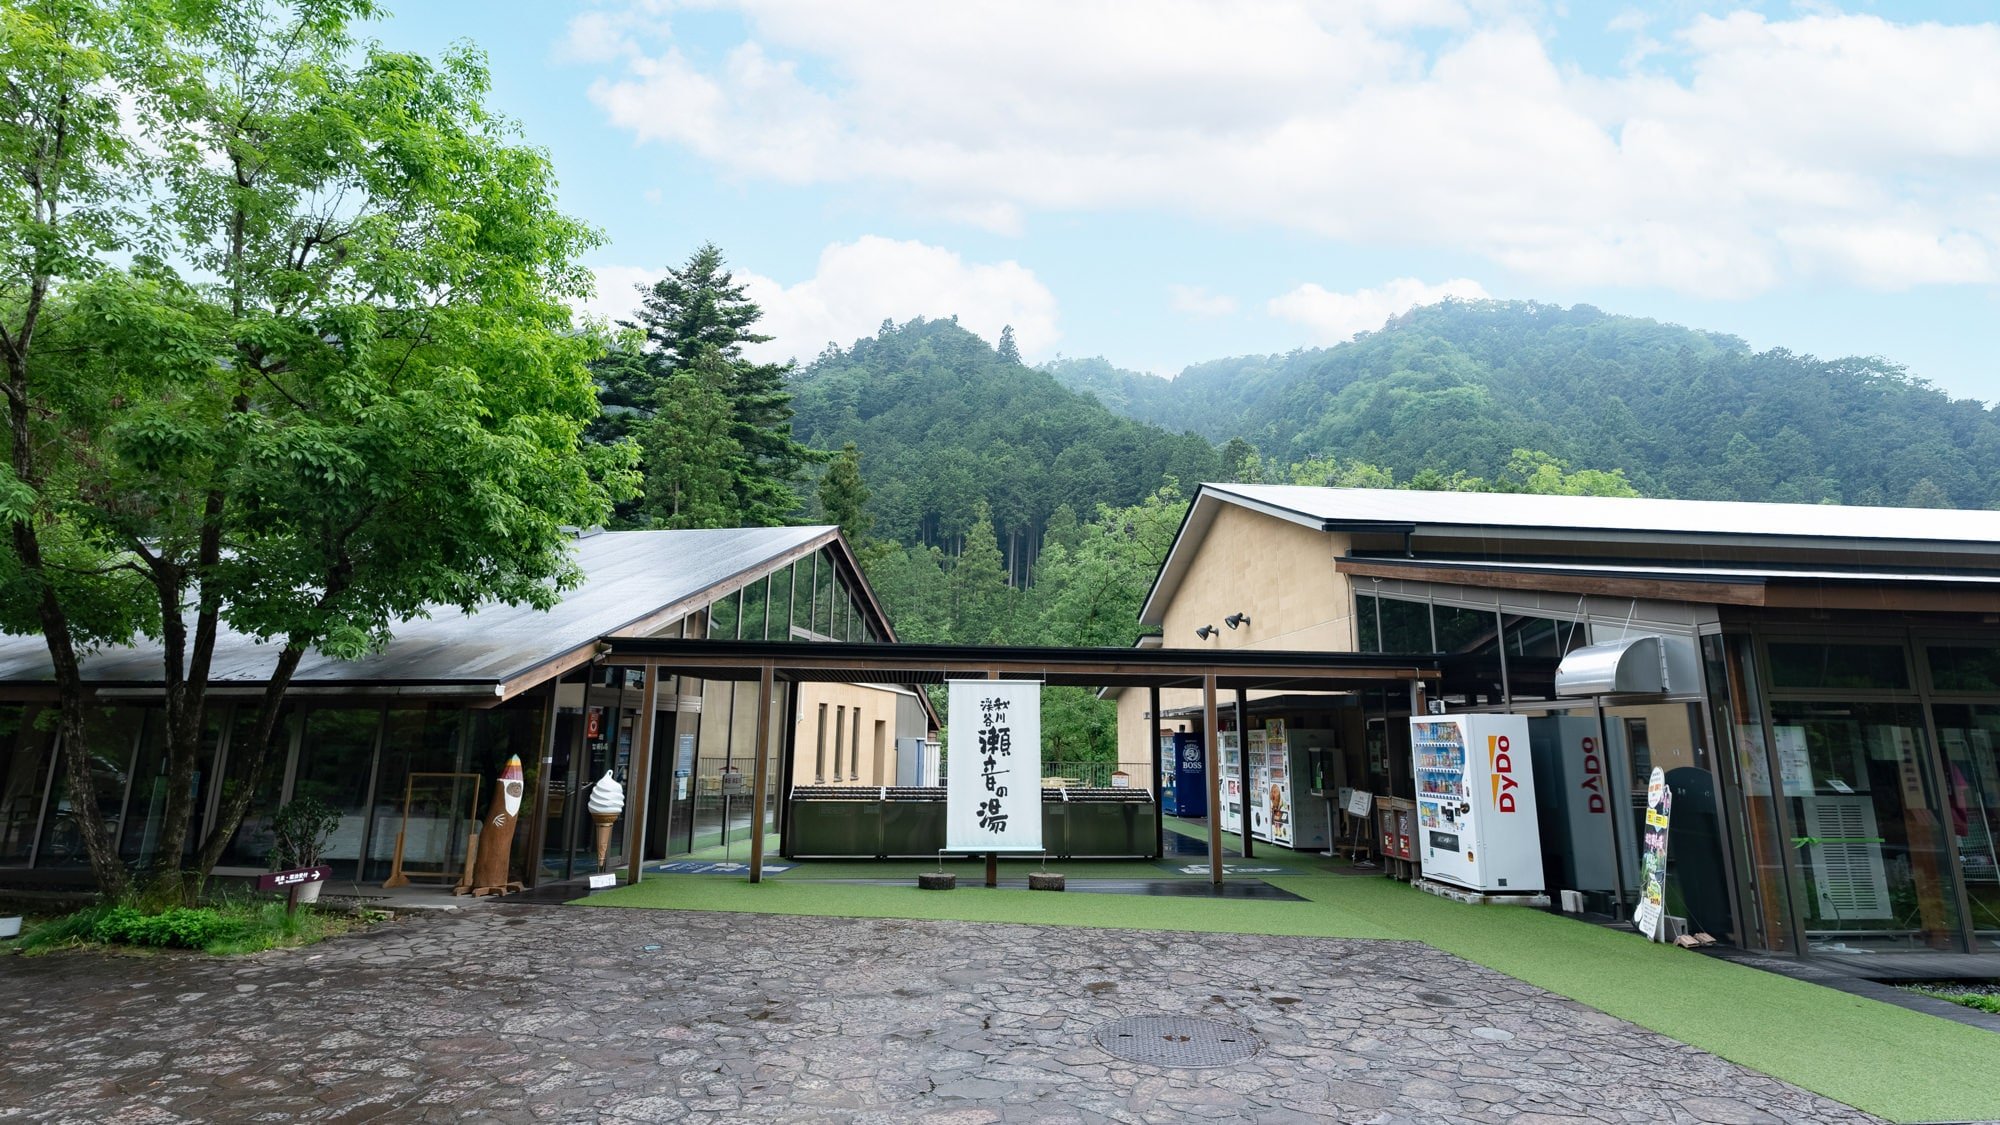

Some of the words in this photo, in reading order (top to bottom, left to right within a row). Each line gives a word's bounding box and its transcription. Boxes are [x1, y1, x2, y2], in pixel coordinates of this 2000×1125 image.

[976, 725, 1011, 834] 瀬音の湯
[1495, 735, 1519, 813] DyDo
